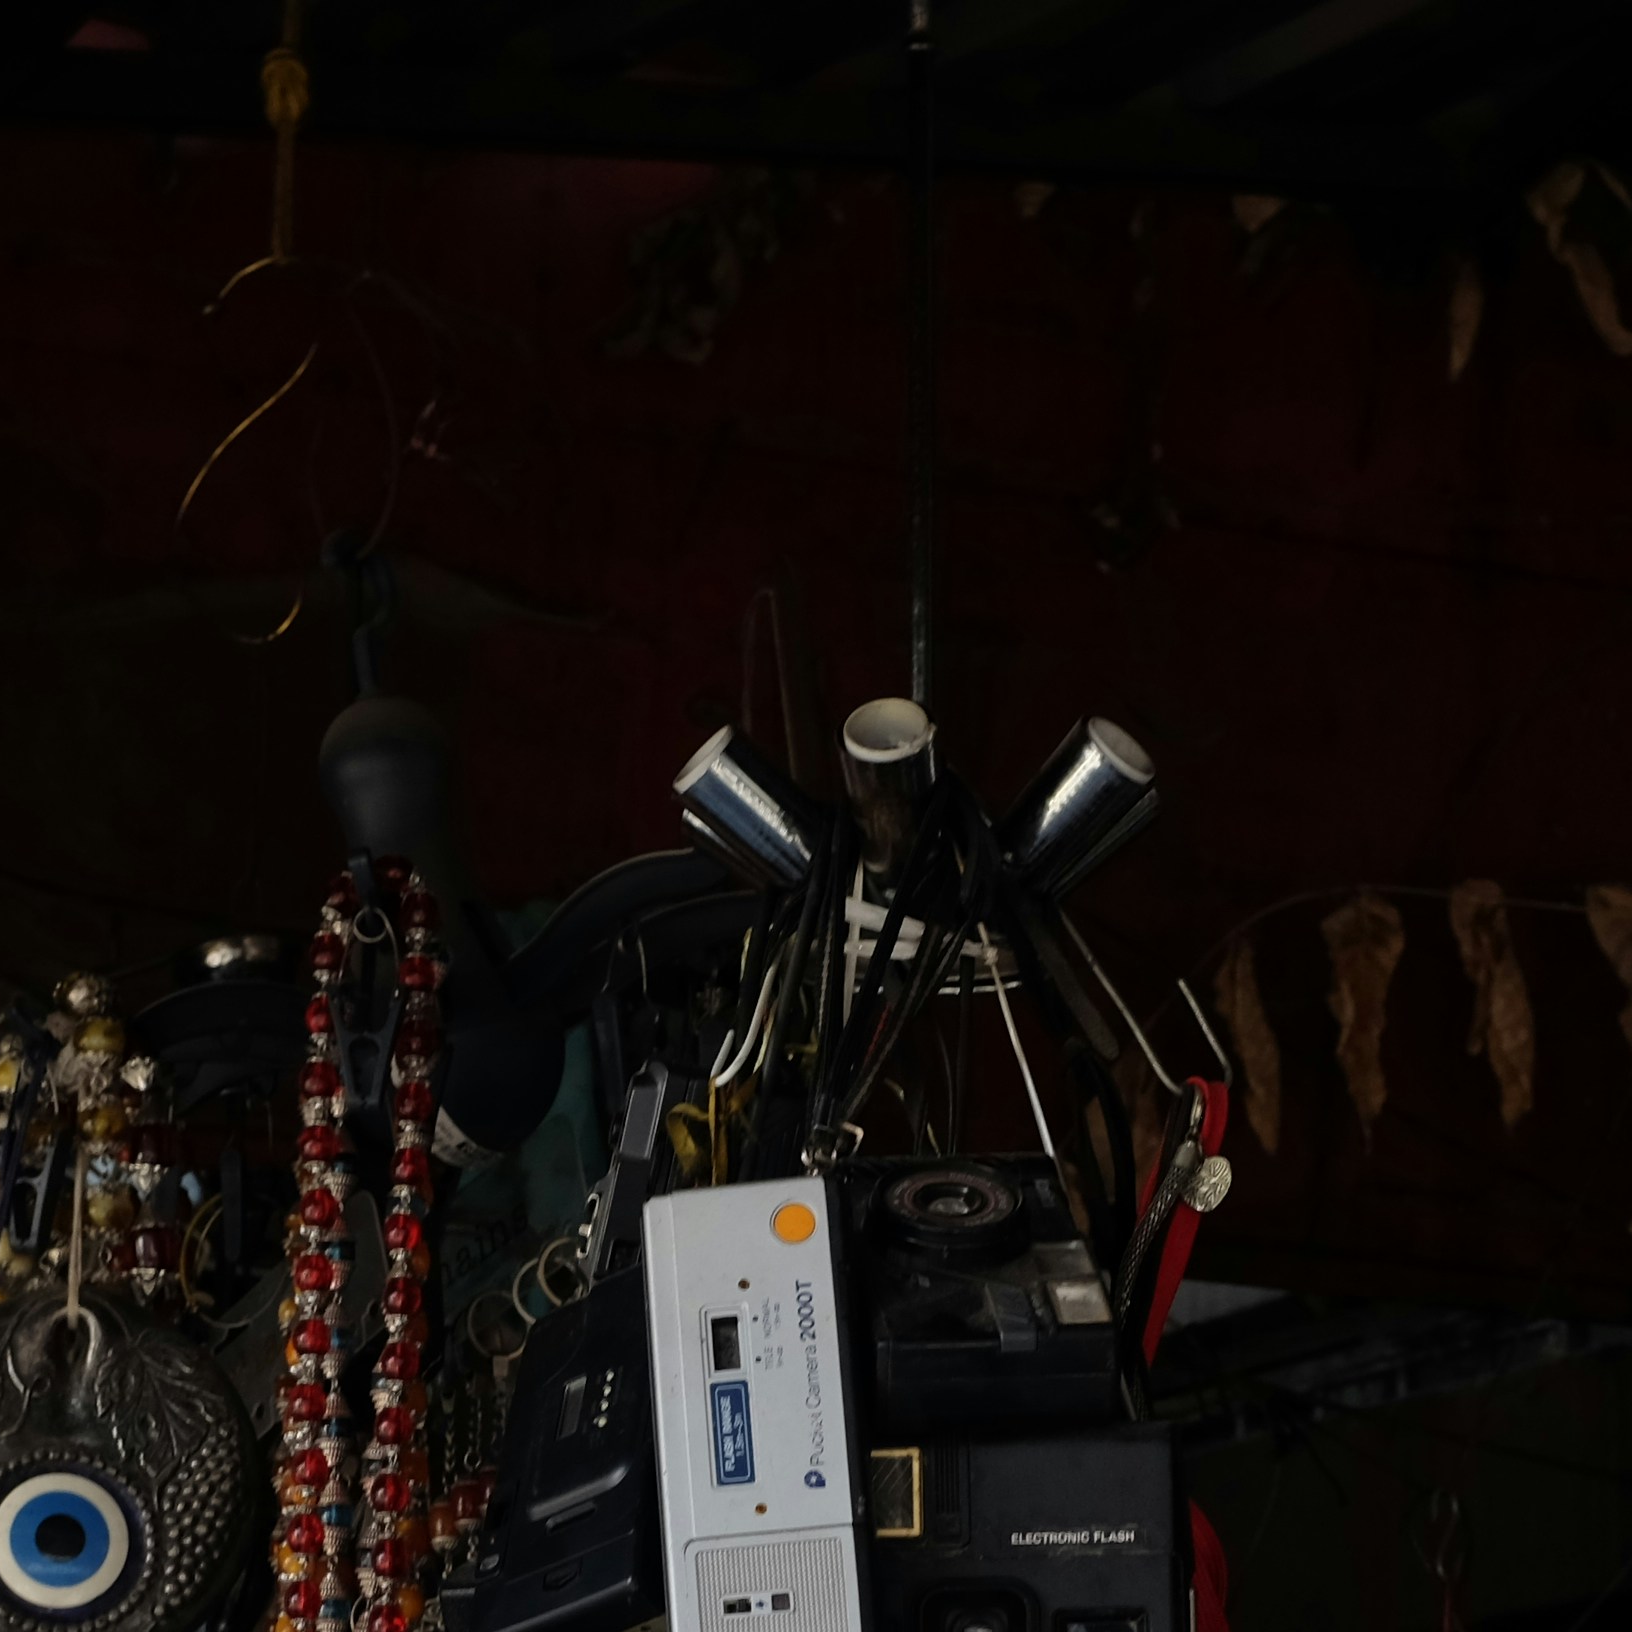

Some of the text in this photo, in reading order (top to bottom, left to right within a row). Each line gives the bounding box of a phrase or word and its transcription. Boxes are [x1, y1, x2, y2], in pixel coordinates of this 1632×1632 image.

[795, 1279, 817, 1342] 2000T
[805, 1345, 822, 1409] Camera
[722, 1435, 736, 1473] FLASH
[1011, 1530, 1135, 1545] ELECTRONIC FLASH
